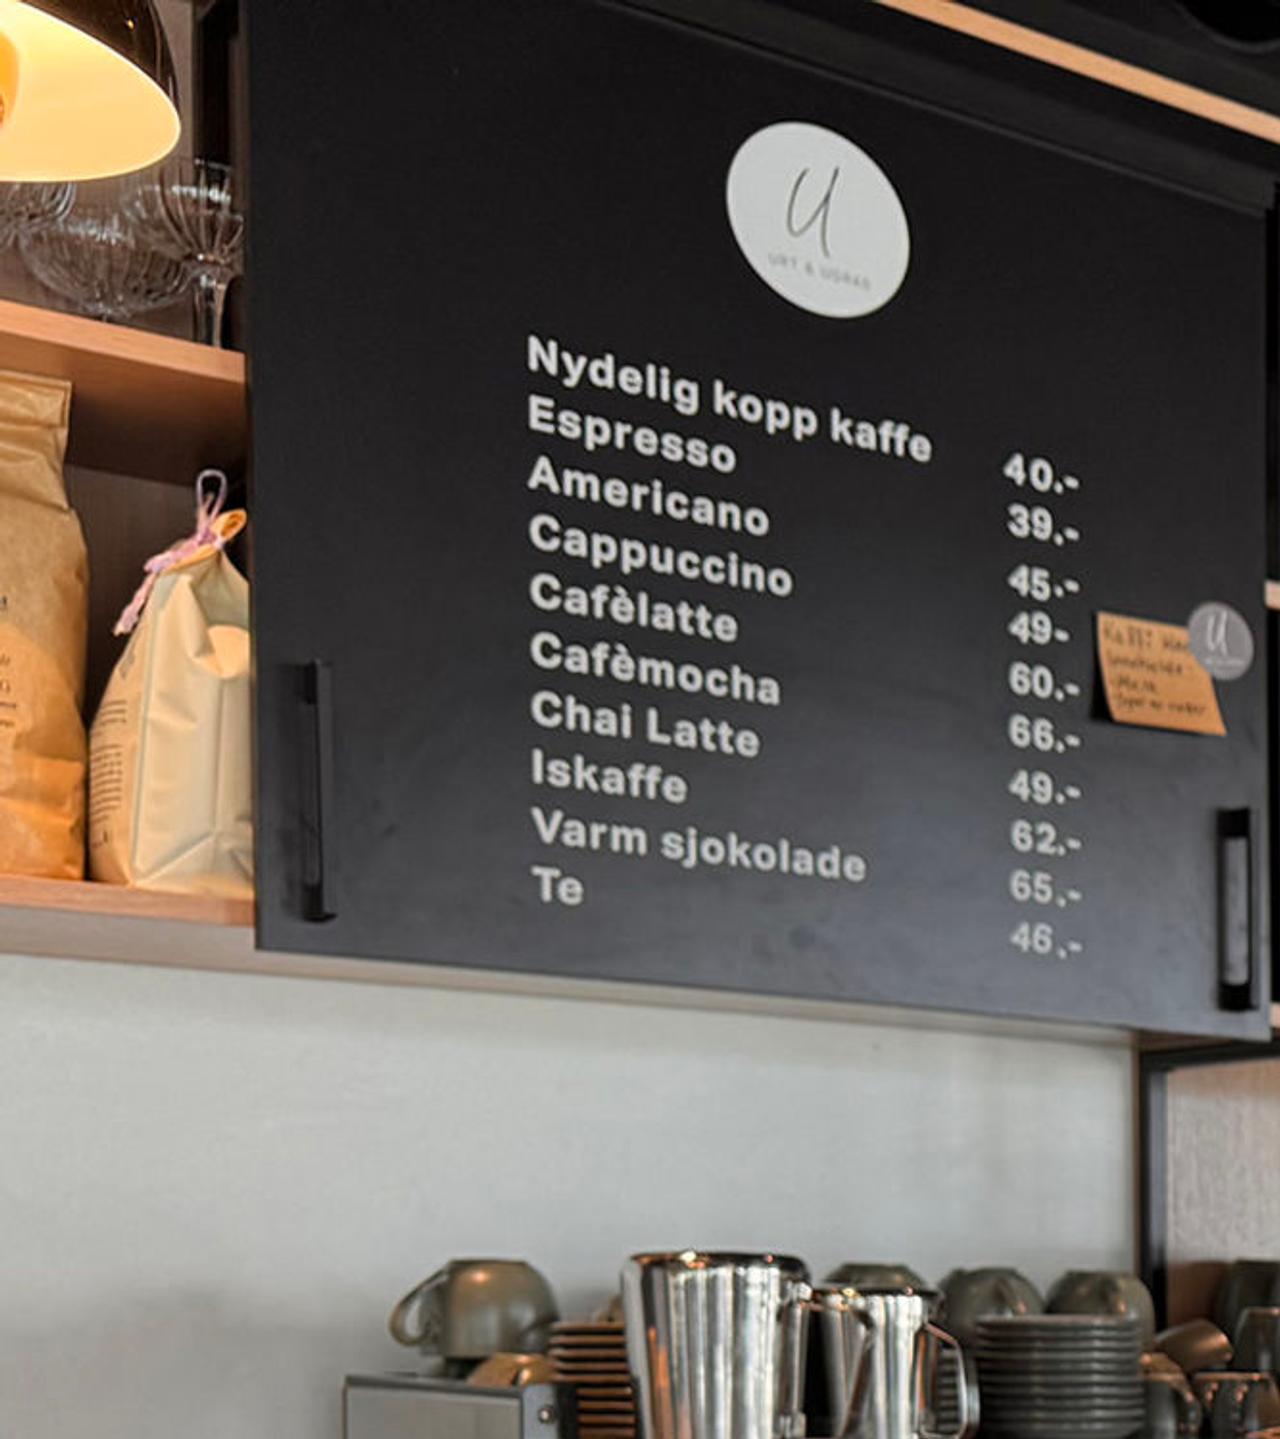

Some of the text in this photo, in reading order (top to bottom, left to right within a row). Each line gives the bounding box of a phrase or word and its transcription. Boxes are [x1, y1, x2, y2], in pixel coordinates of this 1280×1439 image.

[528, 335, 1079, 494] Nydelig kopp kaffe 40.-
[528, 394, 1079, 546] Espresso 39.-
[527, 456, 1079, 601] Americano 45.-
[529, 514, 792, 597] Cappuccino
[1008, 611, 1069, 645] 49-
[530, 573, 738, 642] Cafèlatte
[1009, 662, 1080, 702] 60.-
[530, 632, 1080, 753] Cafèmocha 66.-
[531, 691, 1080, 804] Chai Latte 49.-
[532, 748, 1081, 855] Iskaffe 62.-
[531, 807, 1081, 907] Varm sjokolade 65.-
[531, 866, 1081, 958] Te 46.-
